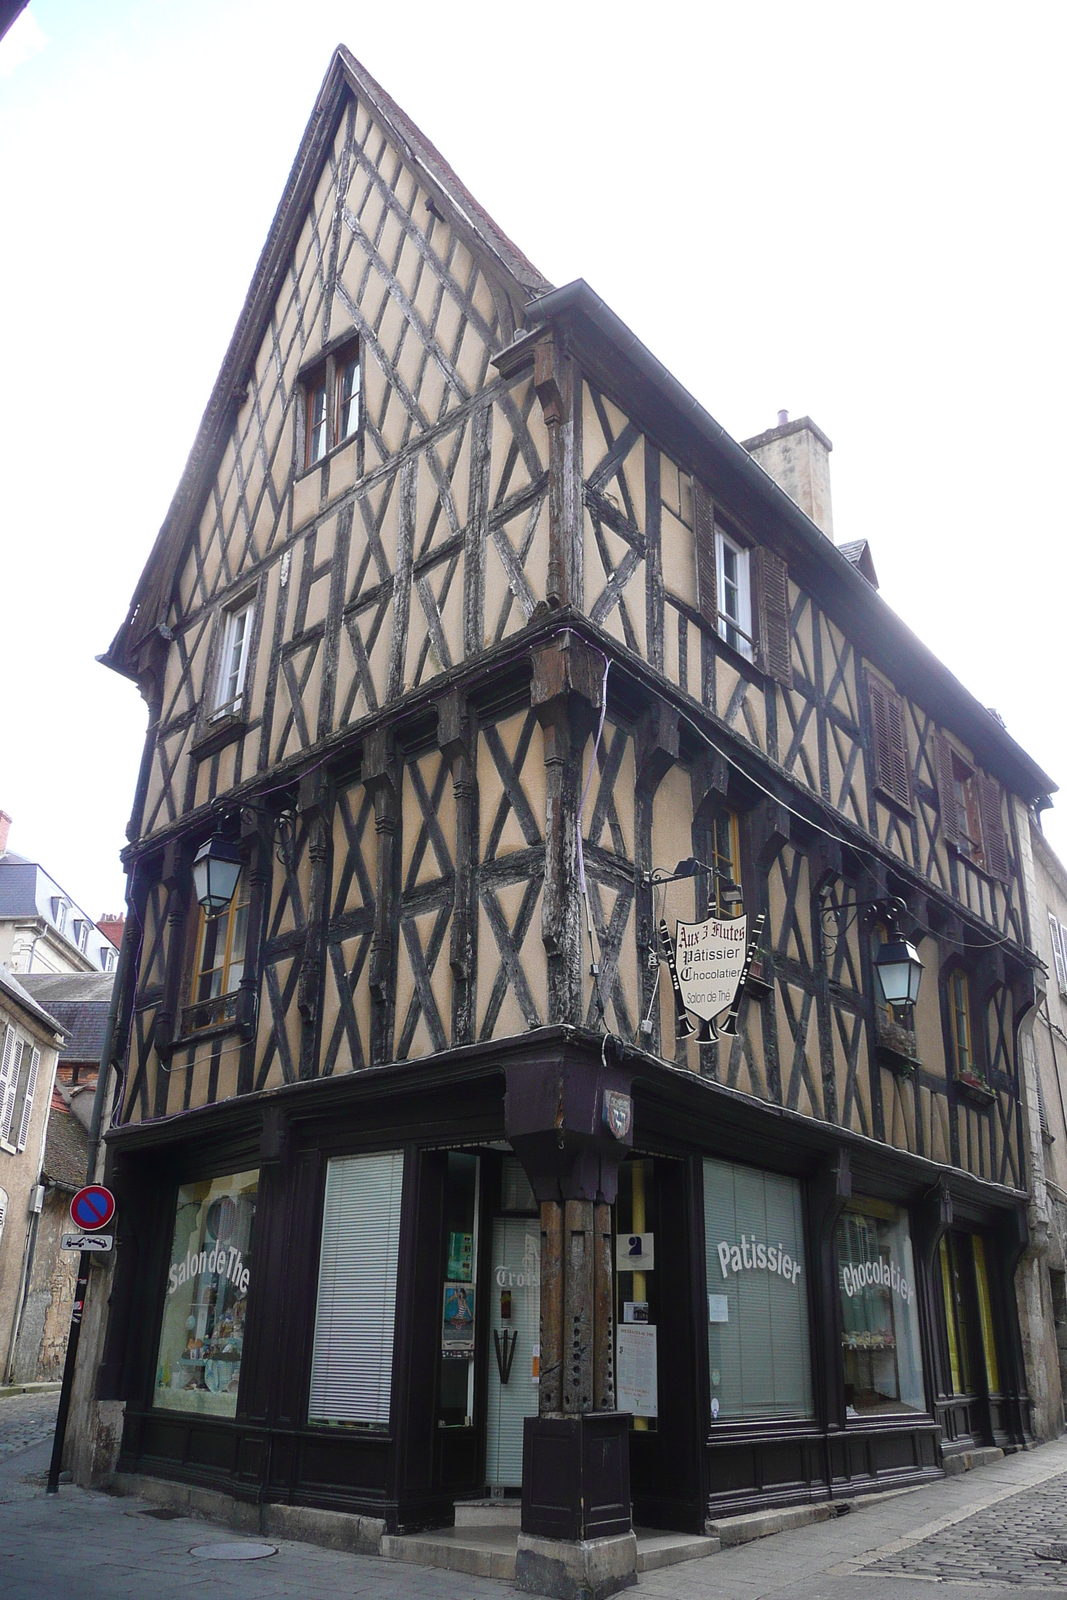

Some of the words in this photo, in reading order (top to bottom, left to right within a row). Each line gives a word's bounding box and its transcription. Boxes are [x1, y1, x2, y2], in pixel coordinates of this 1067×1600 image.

[679, 927, 699, 948] Aux
[702, 925, 708, 940] 3
[711, 921, 744, 941] Flutes
[683, 947, 740, 965] Pâtissier
[680, 966, 741, 982] Chocolatier
[687, 992, 706, 1004] Salon
[707, 991, 717, 1002] de
[718, 989, 731, 1002] Thé
[168, 1250, 207, 1294] Salon
[208, 1239, 226, 1274] de
[226, 1245, 250, 1293] The
[717, 1234, 802, 1285] Patissier
[494, 1264, 540, 1287] Trois
[843, 1255, 914, 1305] Chocolatier
